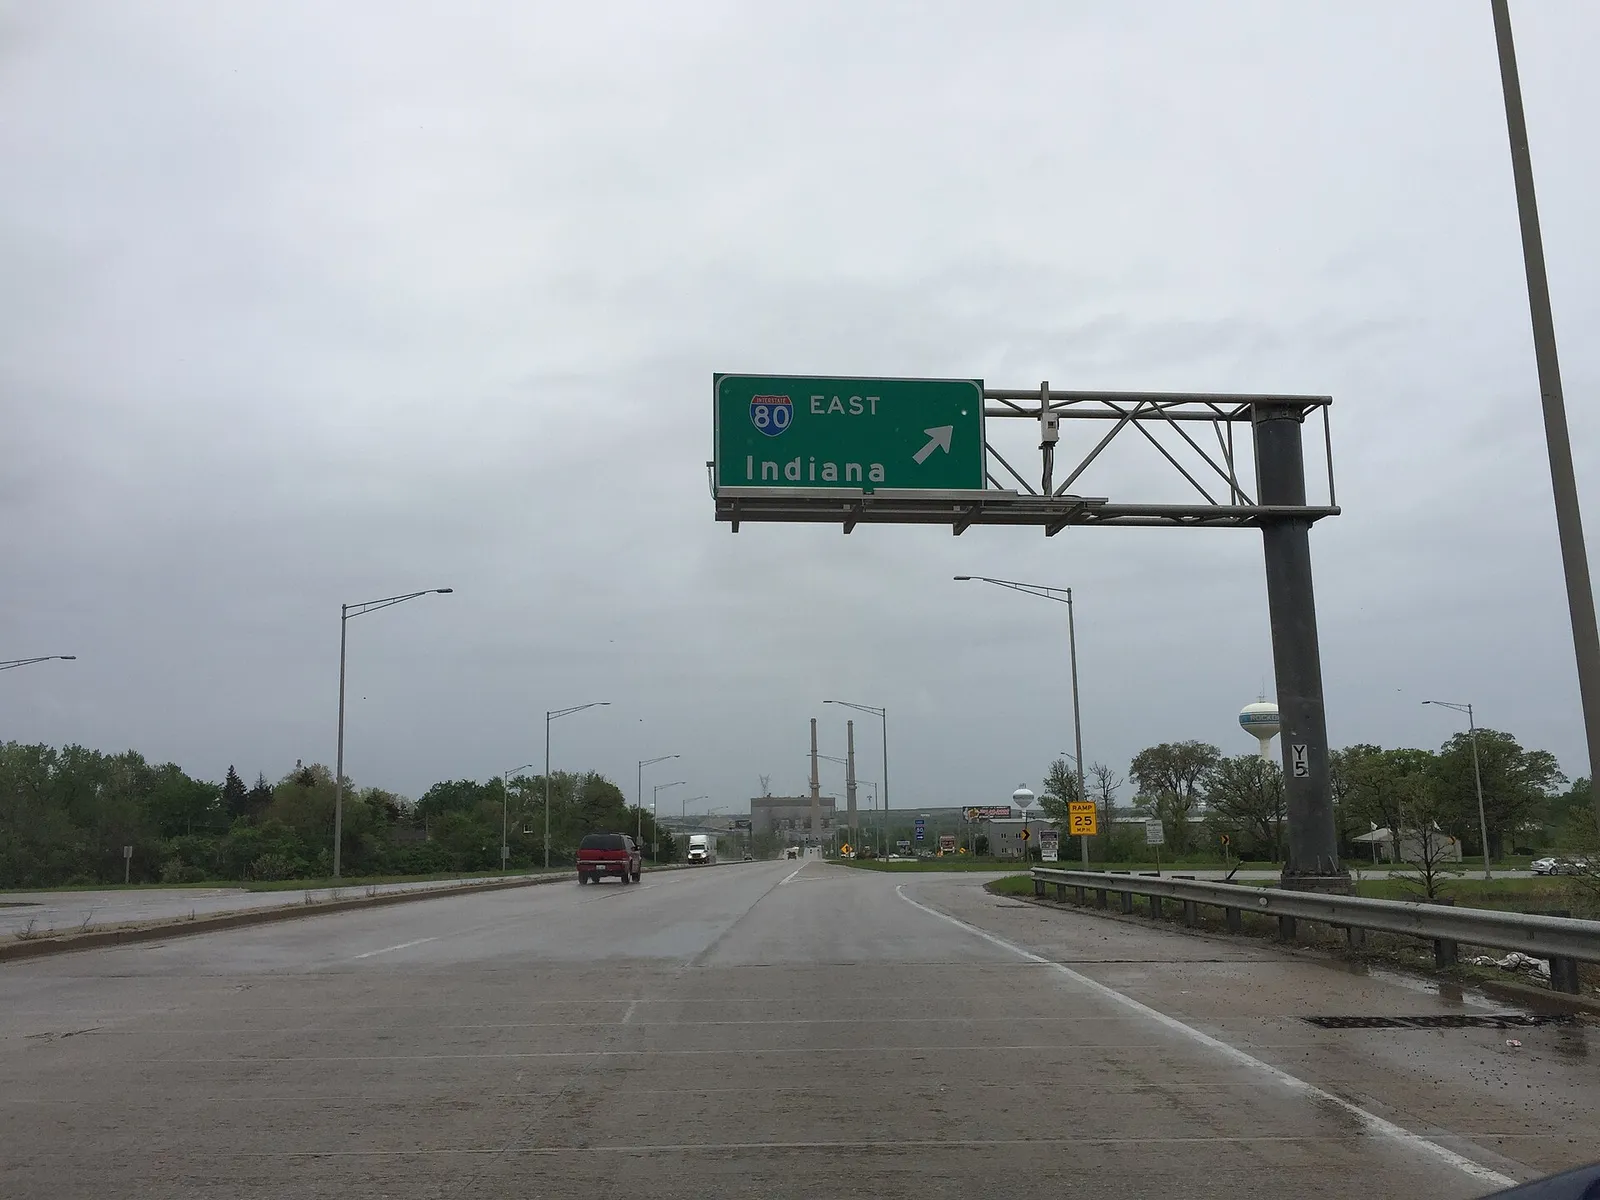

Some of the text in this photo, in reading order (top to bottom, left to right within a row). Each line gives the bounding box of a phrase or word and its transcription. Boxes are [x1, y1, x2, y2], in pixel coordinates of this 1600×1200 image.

[810, 395, 880, 415] EAST
[754, 405, 790, 428] 80
[746, 455, 885, 482] Indiana
[1293, 745, 1306, 760] Y
[1295, 761, 1307, 776] 5
[1074, 816, 1092, 826] 25
